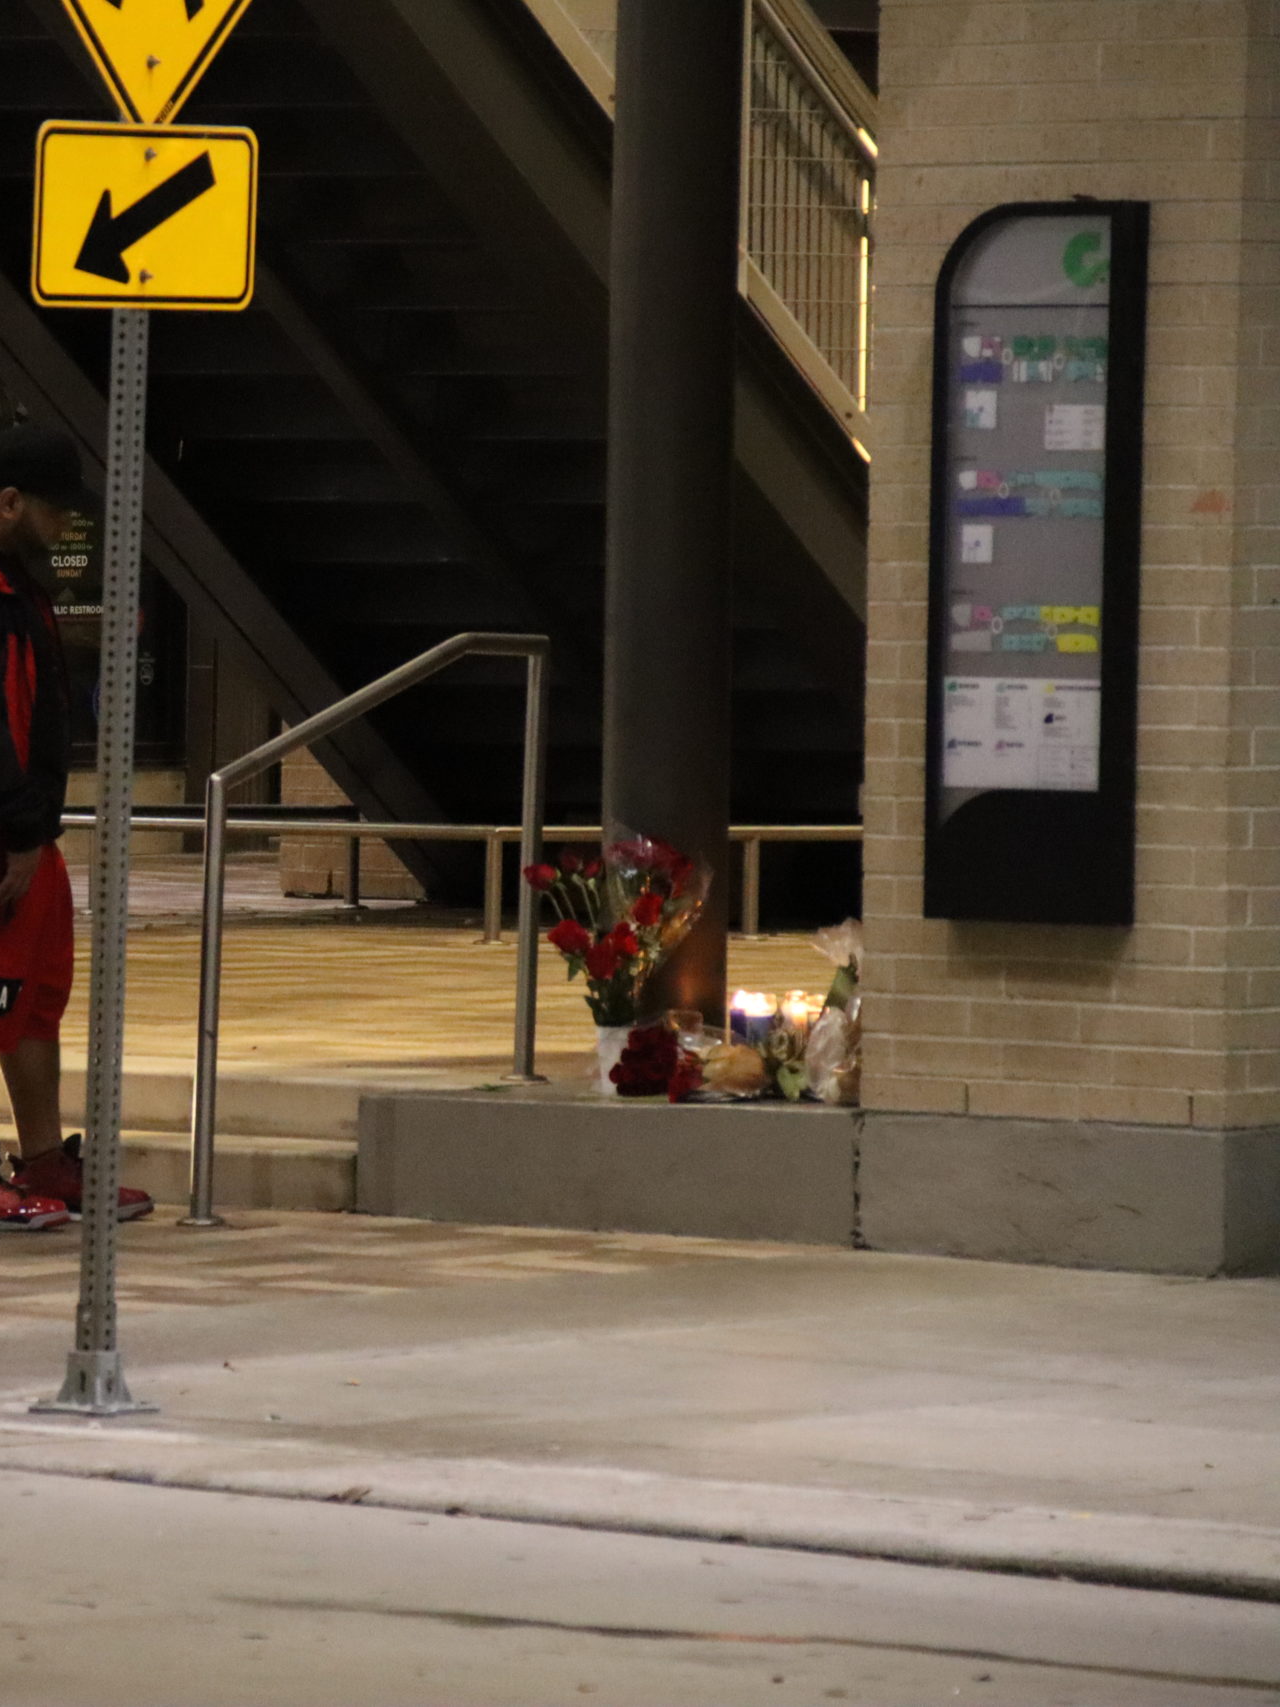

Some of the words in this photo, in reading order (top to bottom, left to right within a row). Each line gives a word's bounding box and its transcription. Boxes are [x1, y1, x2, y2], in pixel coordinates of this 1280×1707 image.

[52, 555, 88, 567] CLOSED
[57, 568, 83, 578] SUNDAY
[69, 605, 104, 615] RESTROO
